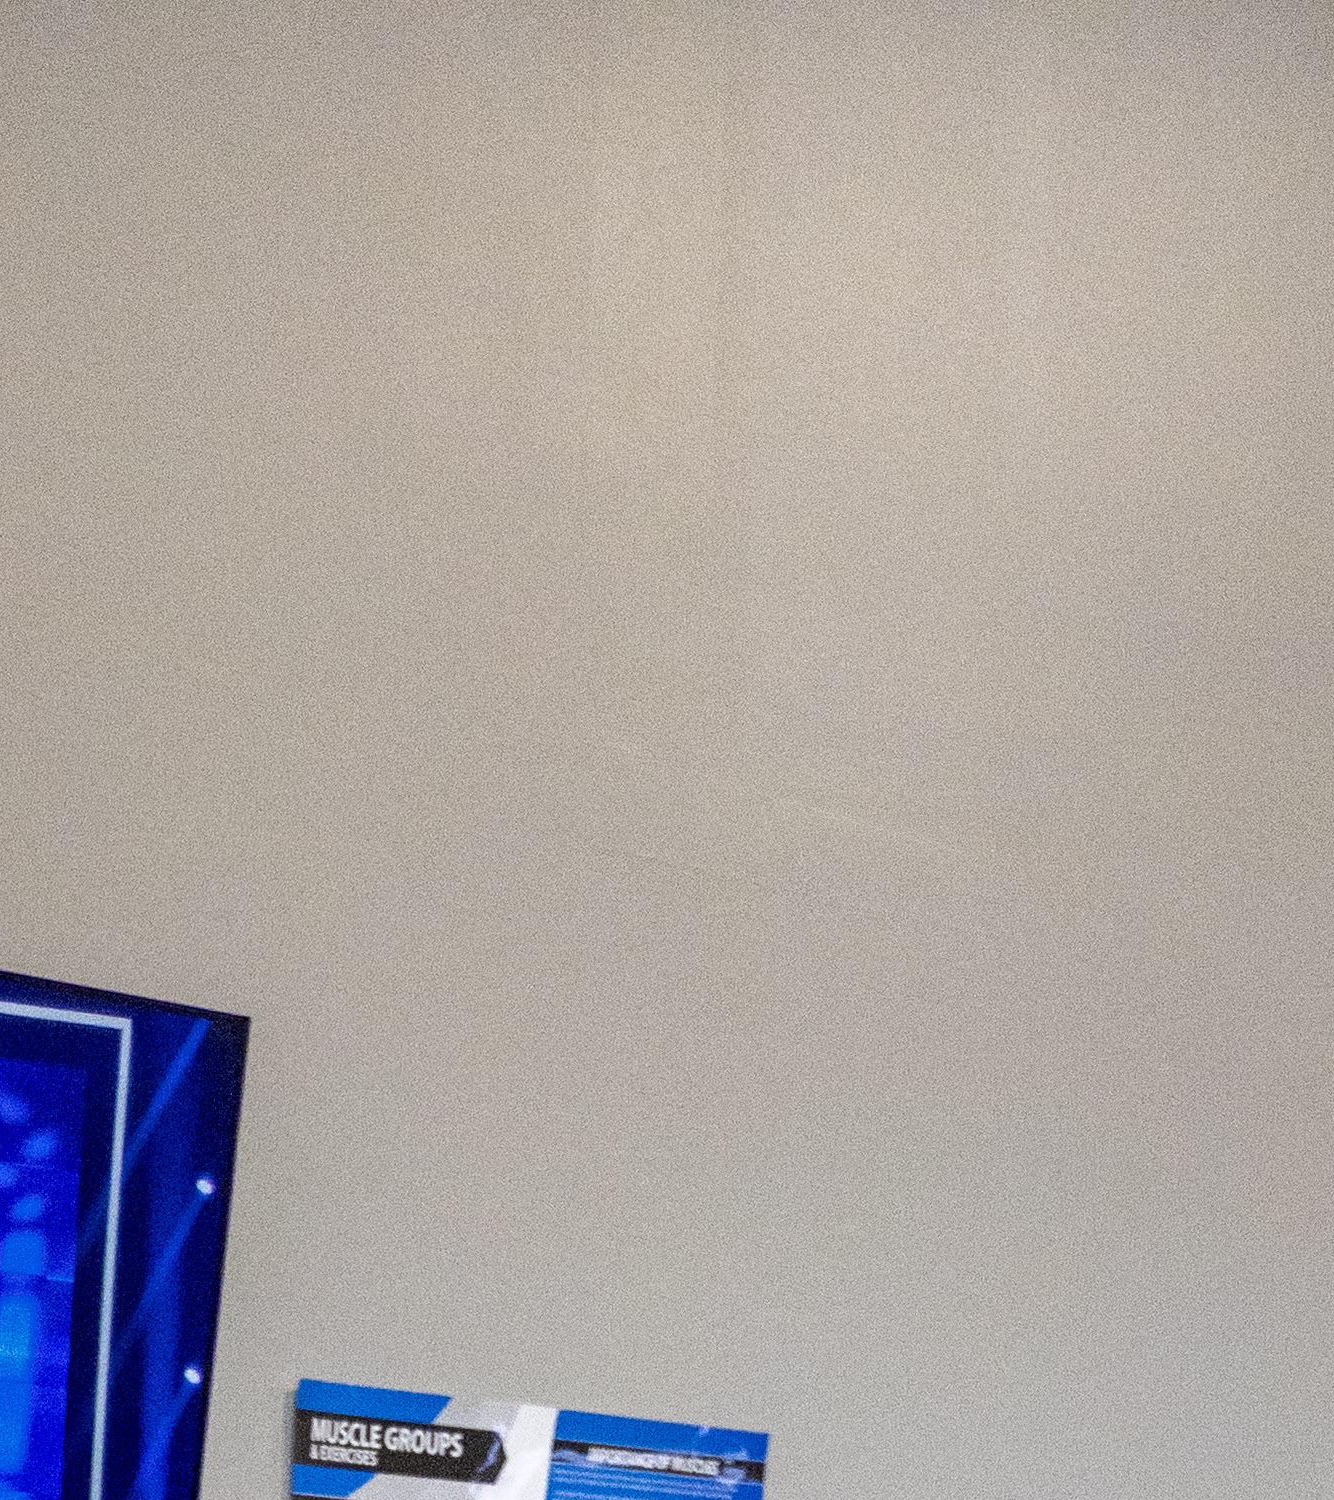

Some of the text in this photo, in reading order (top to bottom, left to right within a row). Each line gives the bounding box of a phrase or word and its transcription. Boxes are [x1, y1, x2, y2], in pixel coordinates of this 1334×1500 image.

[310, 1417, 465, 1459] MUSCLE GROUPS
[309, 1446, 320, 1460] &
